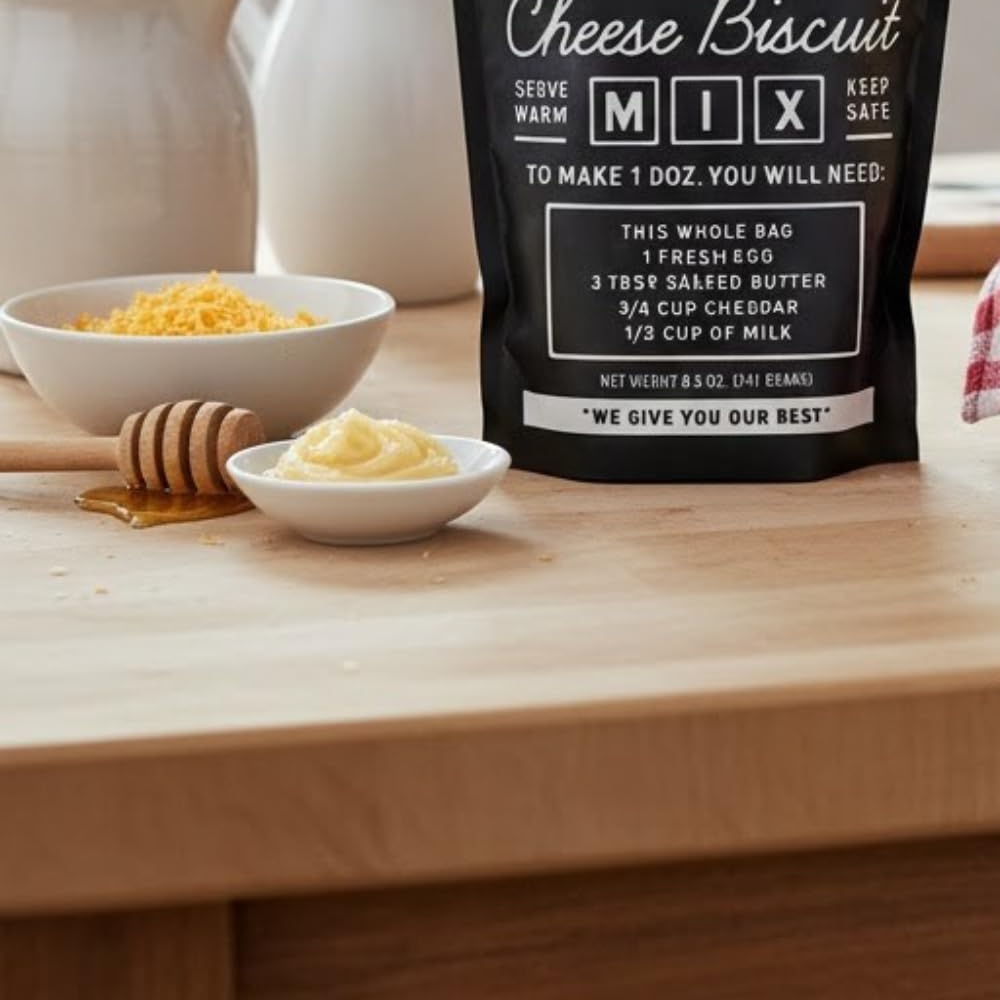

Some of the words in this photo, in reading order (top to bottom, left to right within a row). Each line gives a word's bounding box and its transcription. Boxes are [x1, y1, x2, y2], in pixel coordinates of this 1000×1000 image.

[847, 77, 889, 96] KEEP
[515, 105, 567, 123] WARM
[847, 102, 890, 121] SAFE
[526, 164, 551, 185] TO
[558, 166, 622, 186] MAKE
[631, 166, 640, 186] 1
[650, 166, 703, 187] DOZ.
[708, 166, 756, 186] YOU
[763, 166, 822, 185] WILL
[827, 162, 886, 184] NEED:
[621, 224, 668, 240] THIS
[677, 224, 746, 239] WHOLE
[755, 224, 793, 239] BAG
[642, 249, 650, 265] 1
[659, 249, 727, 265] FRESH
[733, 248, 773, 264] EGG
[591, 274, 602, 291] 3
[751, 273, 826, 290] BUTTER
[618, 300, 650, 319] 3/4
[657, 300, 697, 316] CUP
[624, 325, 655, 344] 1/3
[663, 325, 702, 341] CUP
[710, 325, 735, 341] OF
[744, 325, 792, 341] MILK
[601, 374, 625, 388] NET
[628, 408, 673, 426] GIVE
[679, 409, 721, 426] YOU
[728, 408, 769, 425] OUR
